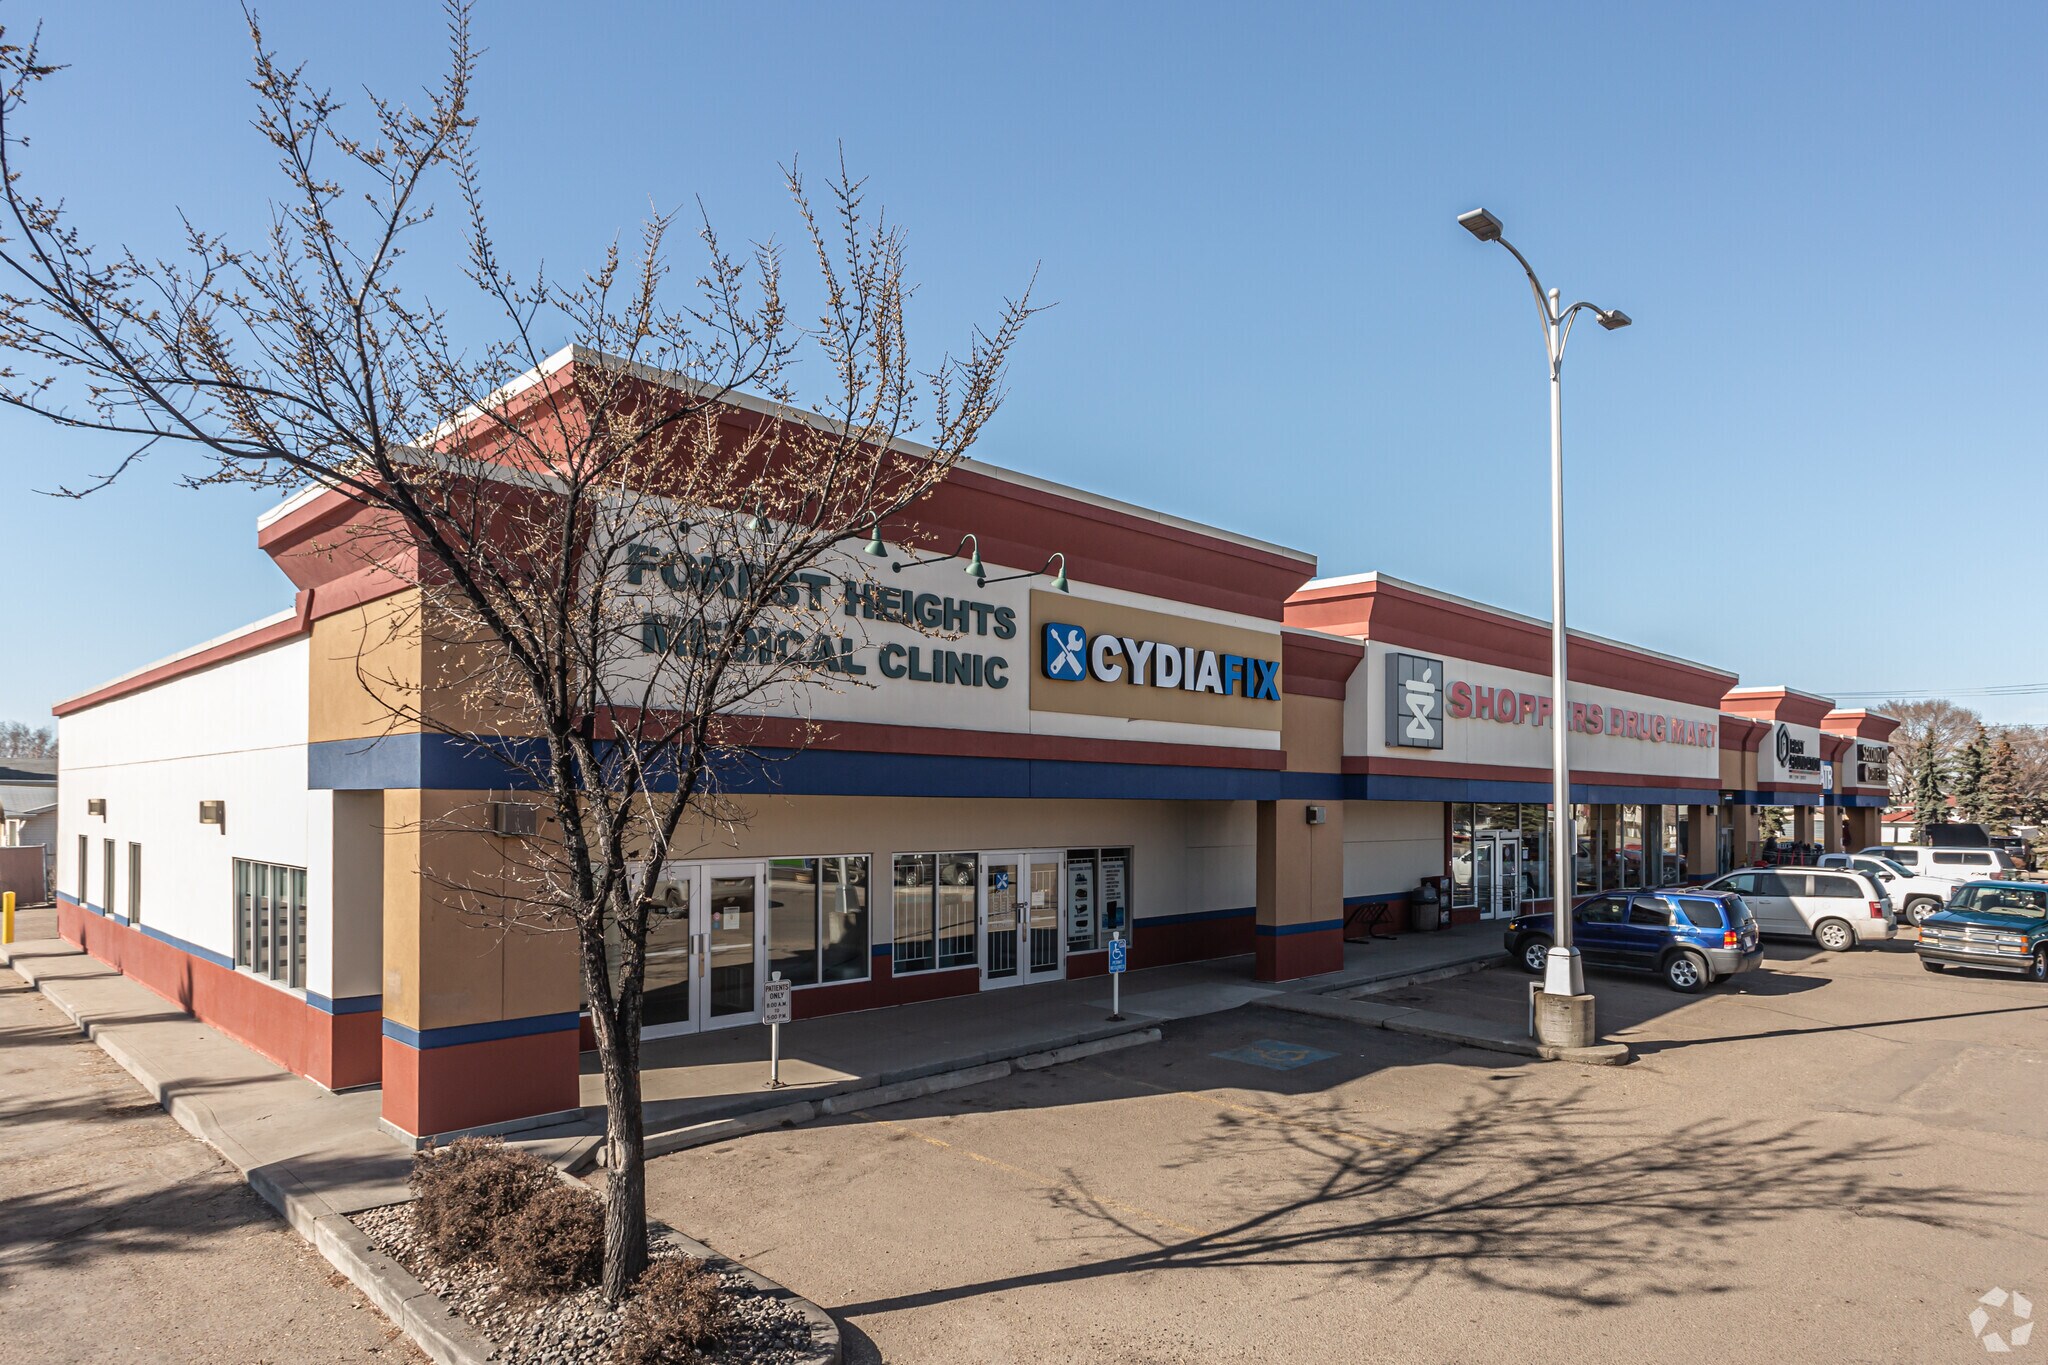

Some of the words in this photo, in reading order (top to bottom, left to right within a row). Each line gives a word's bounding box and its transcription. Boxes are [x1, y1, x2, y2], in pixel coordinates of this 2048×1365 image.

[844, 580, 1017, 640] HEIGHTS
[878, 643, 1009, 690] CLINIC
[1088, 634, 1281, 701] CYDIAFIX
[1446, 681, 1604, 735] SHOPPRS
[1605, 706, 1667, 743] DRUG
[1667, 717, 1718, 748] MART
[766, 984, 788, 992] PATIENTS
